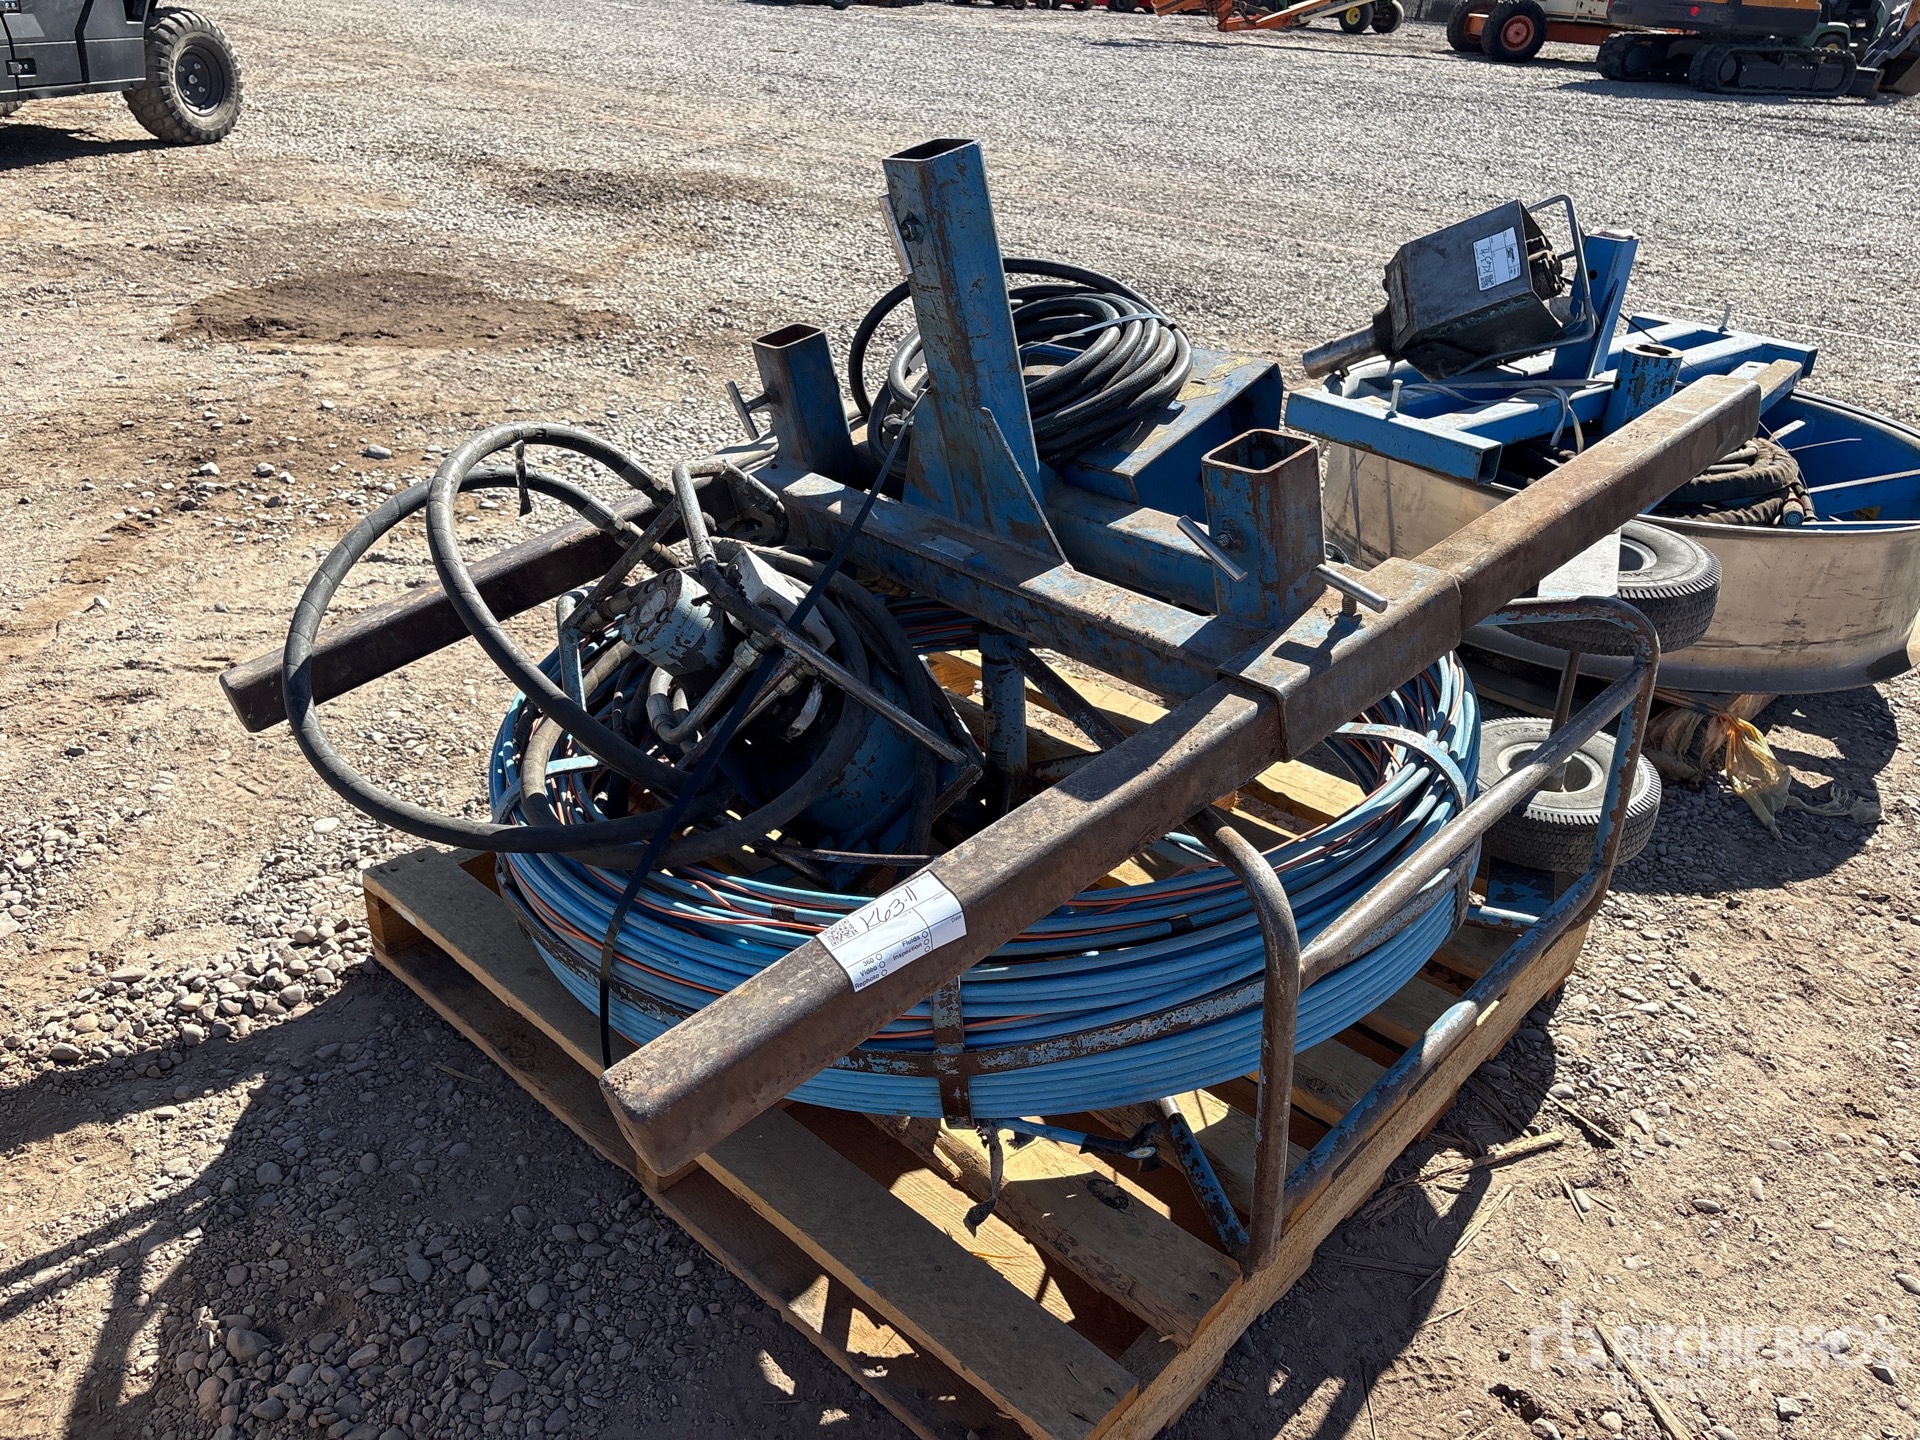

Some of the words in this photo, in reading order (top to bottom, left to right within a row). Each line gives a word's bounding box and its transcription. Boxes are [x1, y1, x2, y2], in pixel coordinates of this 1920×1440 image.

[860, 885, 918, 931] K63-11
[951, 914, 962, 923] Date
[901, 934, 921, 948] Fluids
[892, 941, 923, 961] Inspection
[863, 957, 875, 967] 360
[859, 966, 878, 977] Video
[854, 973, 880, 989] Rephoto
